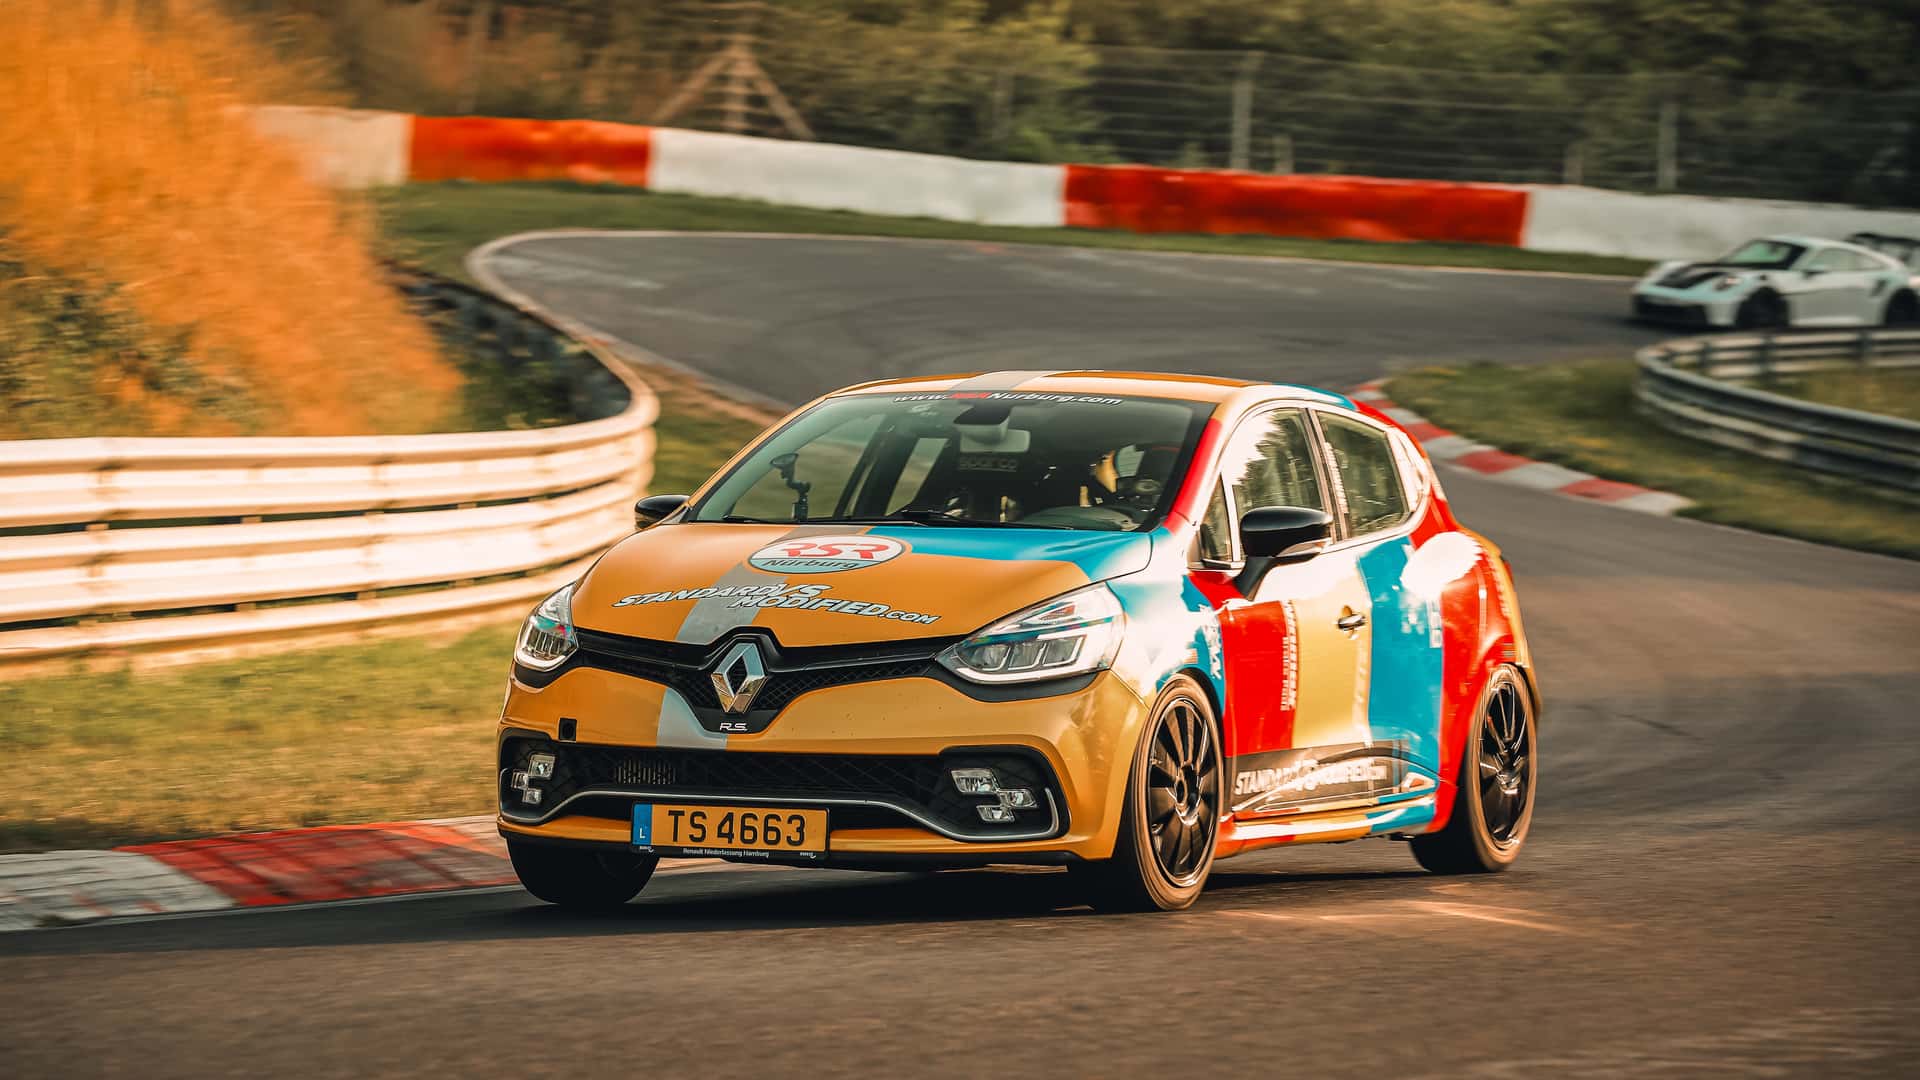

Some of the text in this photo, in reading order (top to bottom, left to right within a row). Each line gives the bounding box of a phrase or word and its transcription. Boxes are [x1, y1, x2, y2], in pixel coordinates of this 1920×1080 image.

[783, 543, 889, 559] RSR
[640, 827, 646, 839] L
[668, 810, 806, 847] TS 4663
